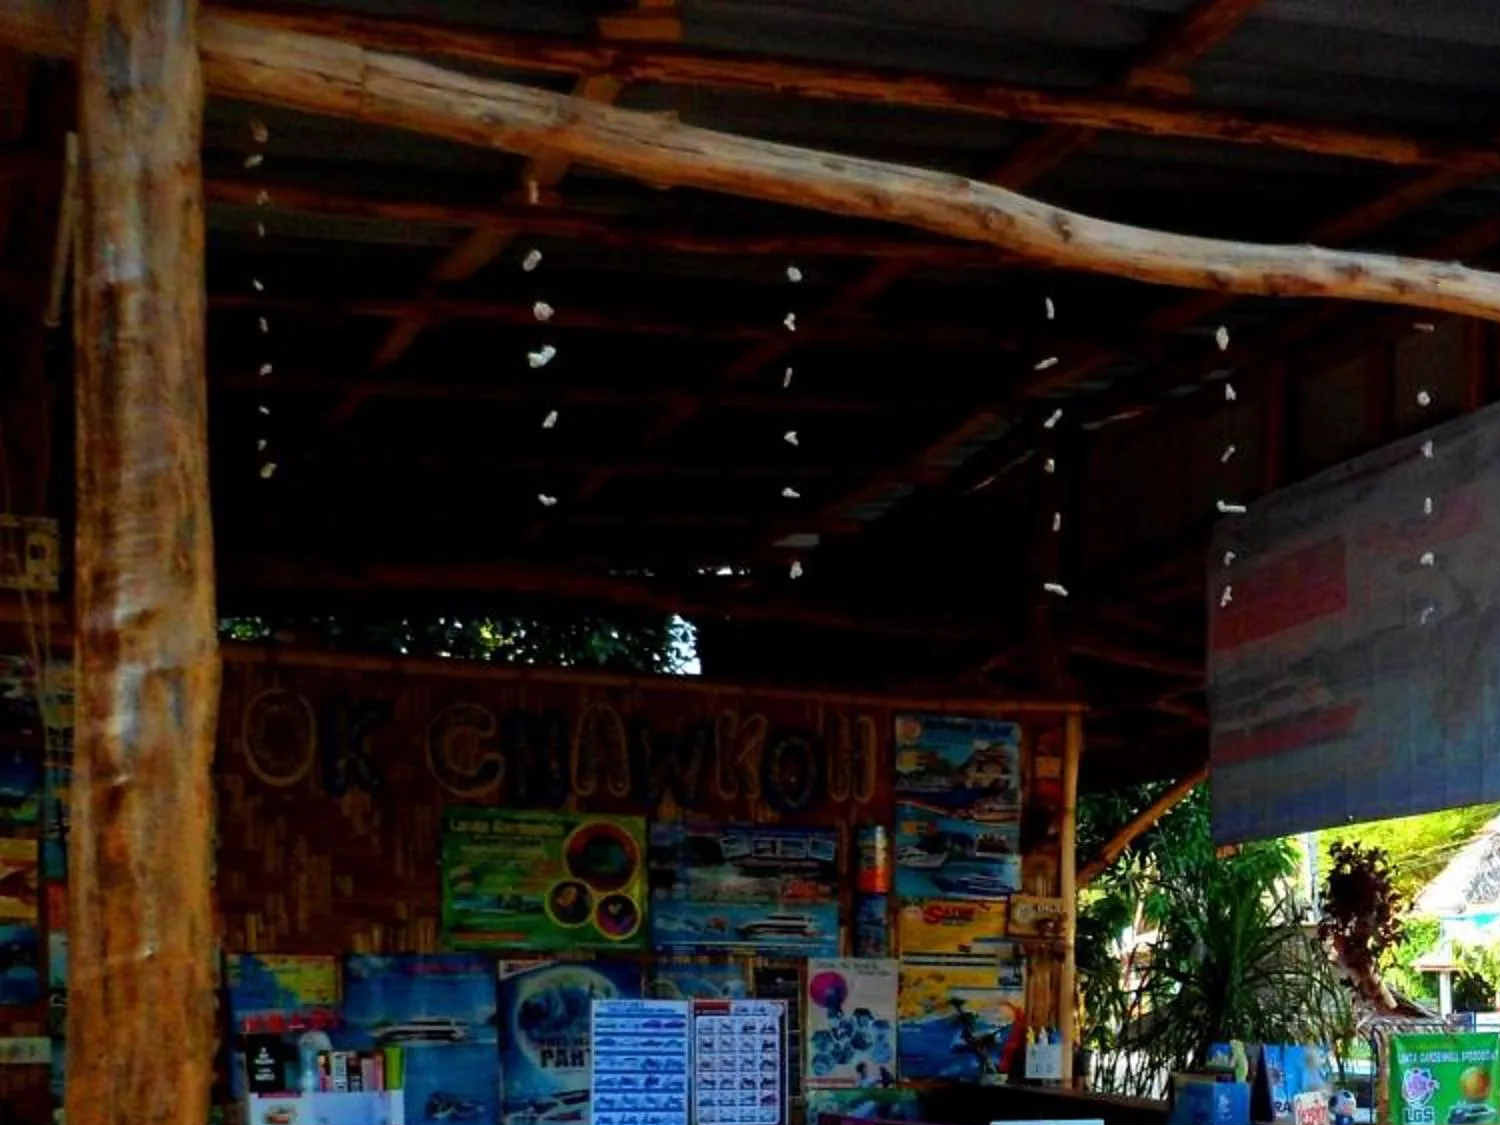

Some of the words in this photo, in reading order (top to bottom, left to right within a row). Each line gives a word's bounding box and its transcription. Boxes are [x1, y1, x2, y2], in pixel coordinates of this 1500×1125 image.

[243, 687, 392, 797] OK
[540, 1048, 590, 1067] PAR
[1404, 1107, 1434, 1123] LGS
